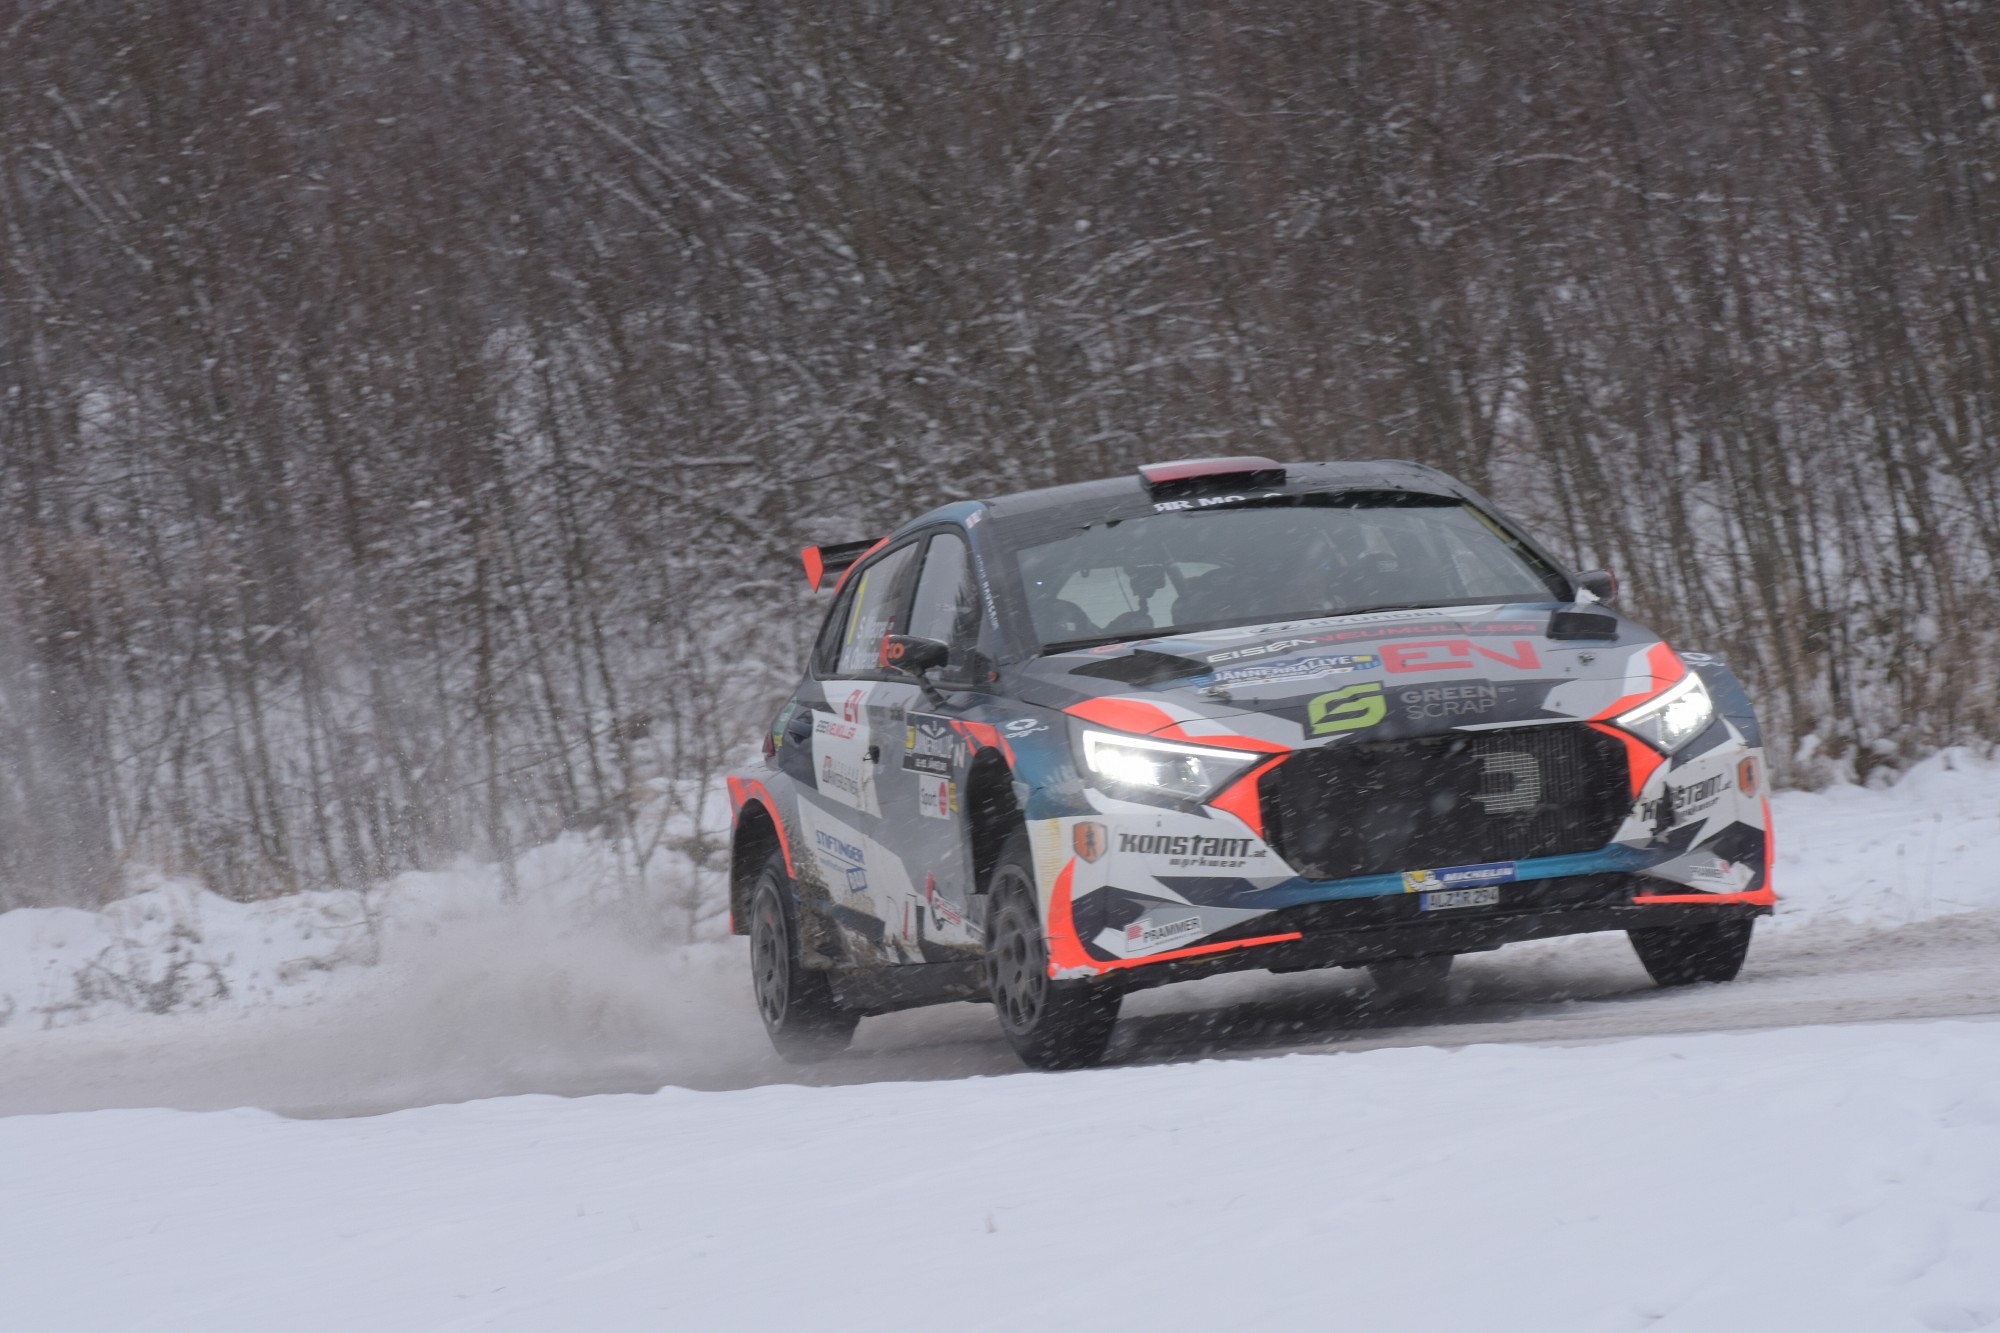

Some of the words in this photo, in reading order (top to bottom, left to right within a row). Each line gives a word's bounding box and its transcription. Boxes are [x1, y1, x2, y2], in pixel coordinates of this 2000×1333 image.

[1401, 685, 1498, 704] GREEN
[1406, 699, 1497, 720] SCRAP
[1443, 867, 1514, 882] MICHELIN
[1143, 917, 1199, 943] PRAMMER
